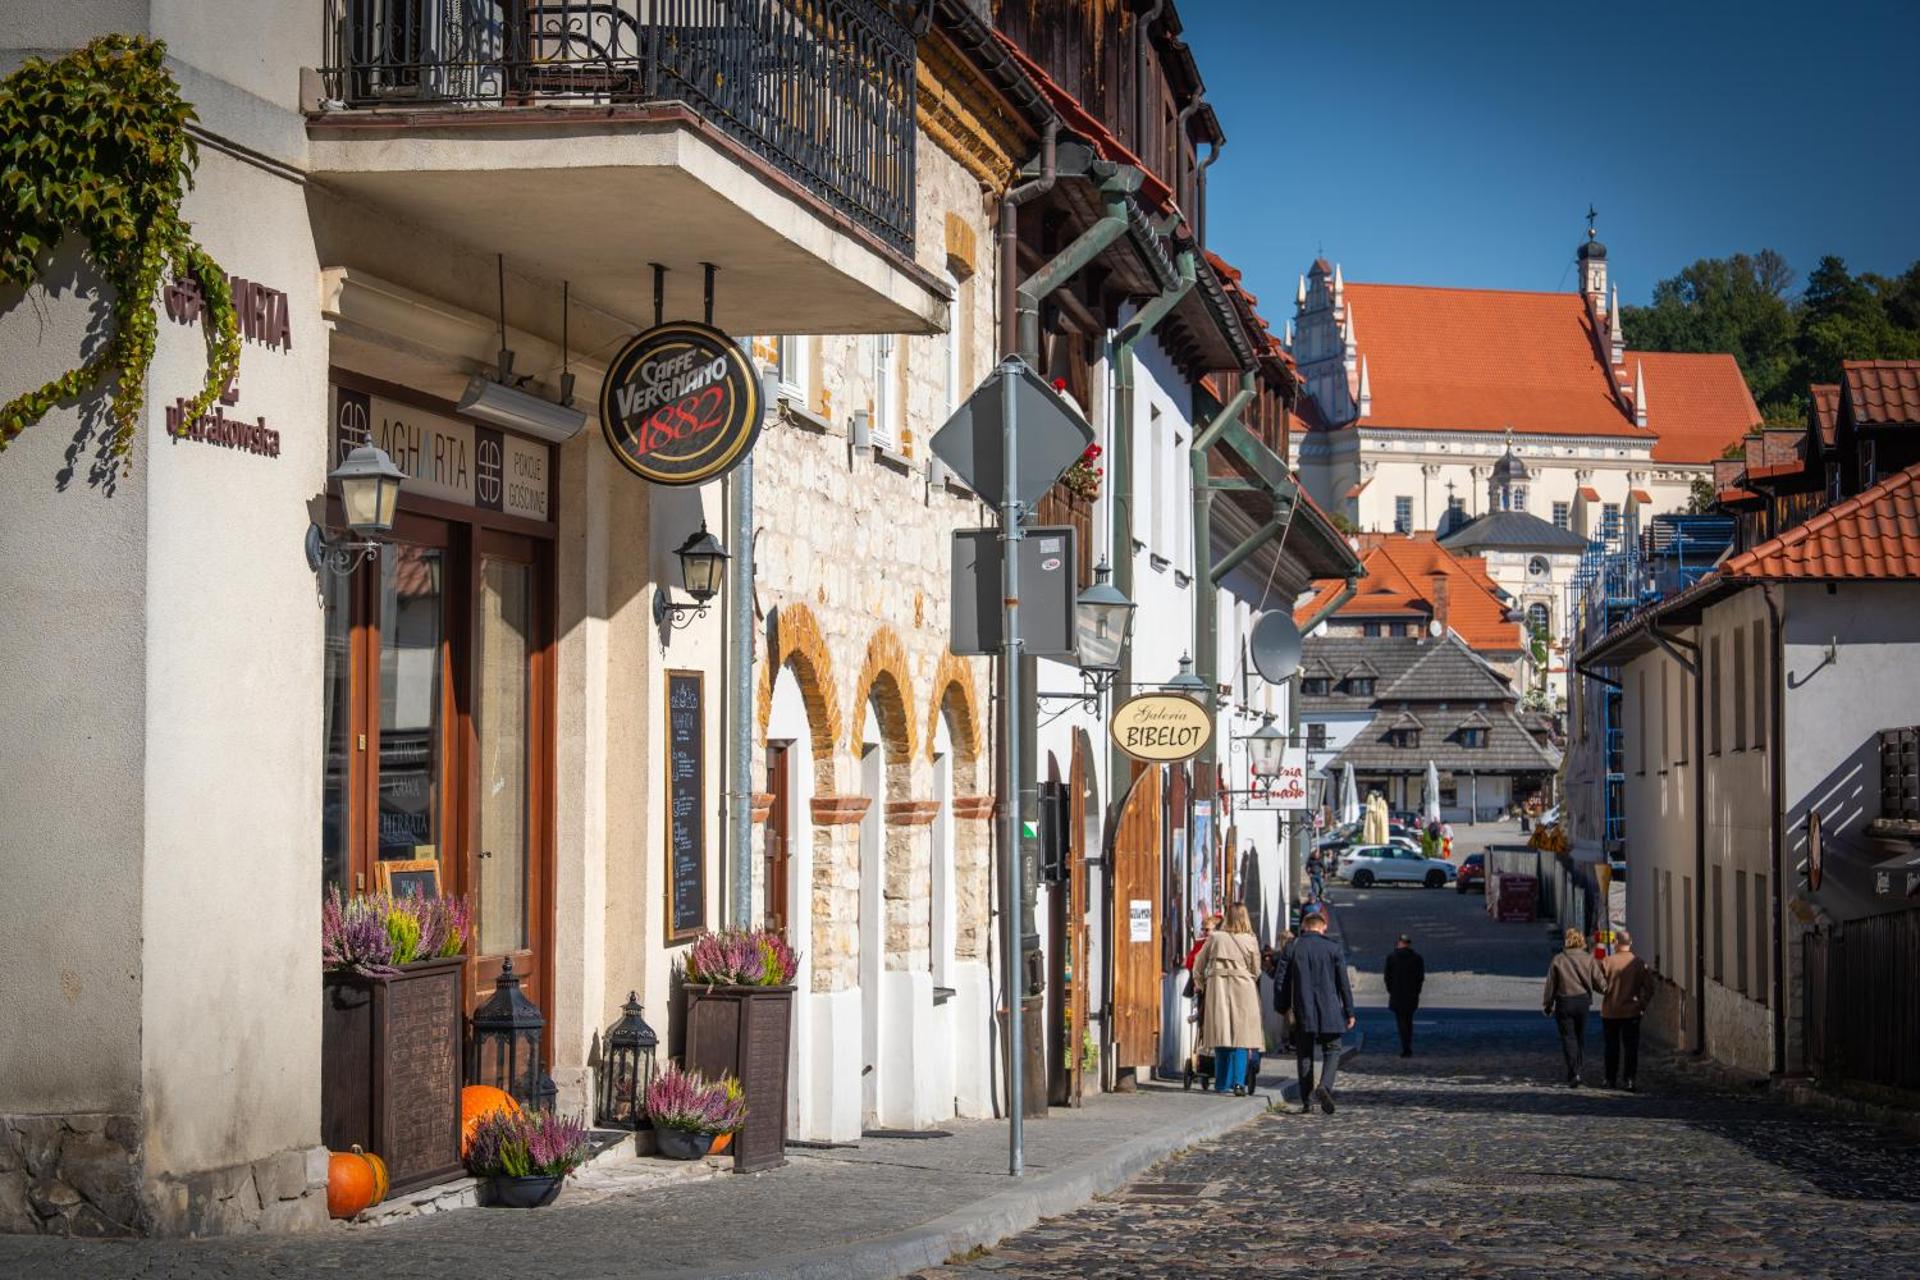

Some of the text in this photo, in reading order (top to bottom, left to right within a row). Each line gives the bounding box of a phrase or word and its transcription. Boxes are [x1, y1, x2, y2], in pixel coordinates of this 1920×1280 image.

[616, 356, 727, 421] VERGNANO
[635, 386, 724, 455] 1882
[380, 418, 468, 489] AGHARTA
[513, 451, 542, 481] POKOJE
[508, 481, 546, 514] GOŚCINNE
[1132, 704, 1187, 724] Galeria
[1126, 726, 1202, 747] BIBELOT
[383, 812, 428, 834] HERBATA
